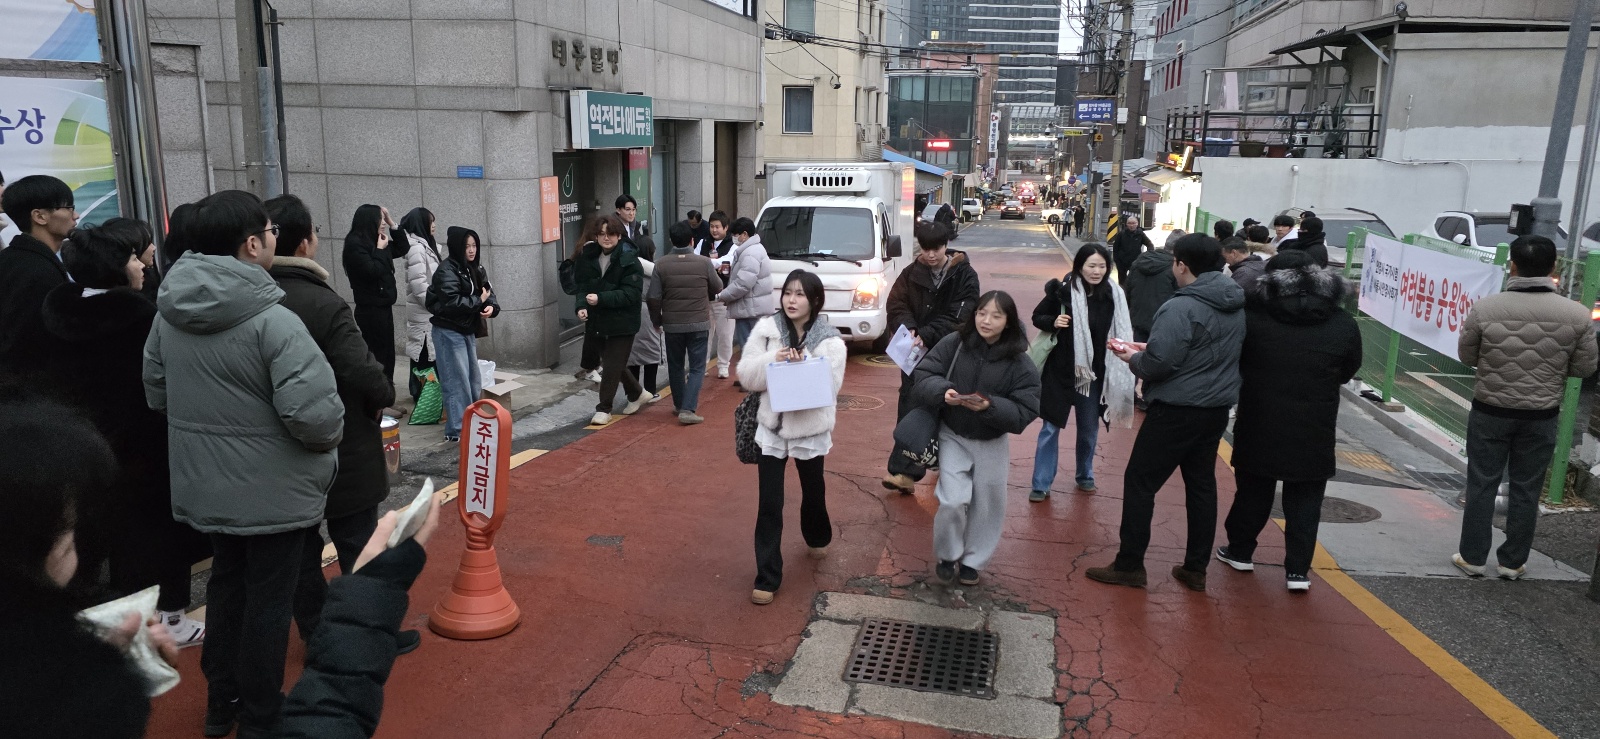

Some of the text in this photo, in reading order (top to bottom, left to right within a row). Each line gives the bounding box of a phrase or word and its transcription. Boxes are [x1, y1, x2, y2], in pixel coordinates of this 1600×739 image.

[589, 103, 645, 136] 역전타에듀
[645, 106, 651, 136] 학원
[1400, 267, 1435, 322] 여러분을
[1436, 277, 1480, 334] 응원합
[471, 421, 493, 510] 주차금지
